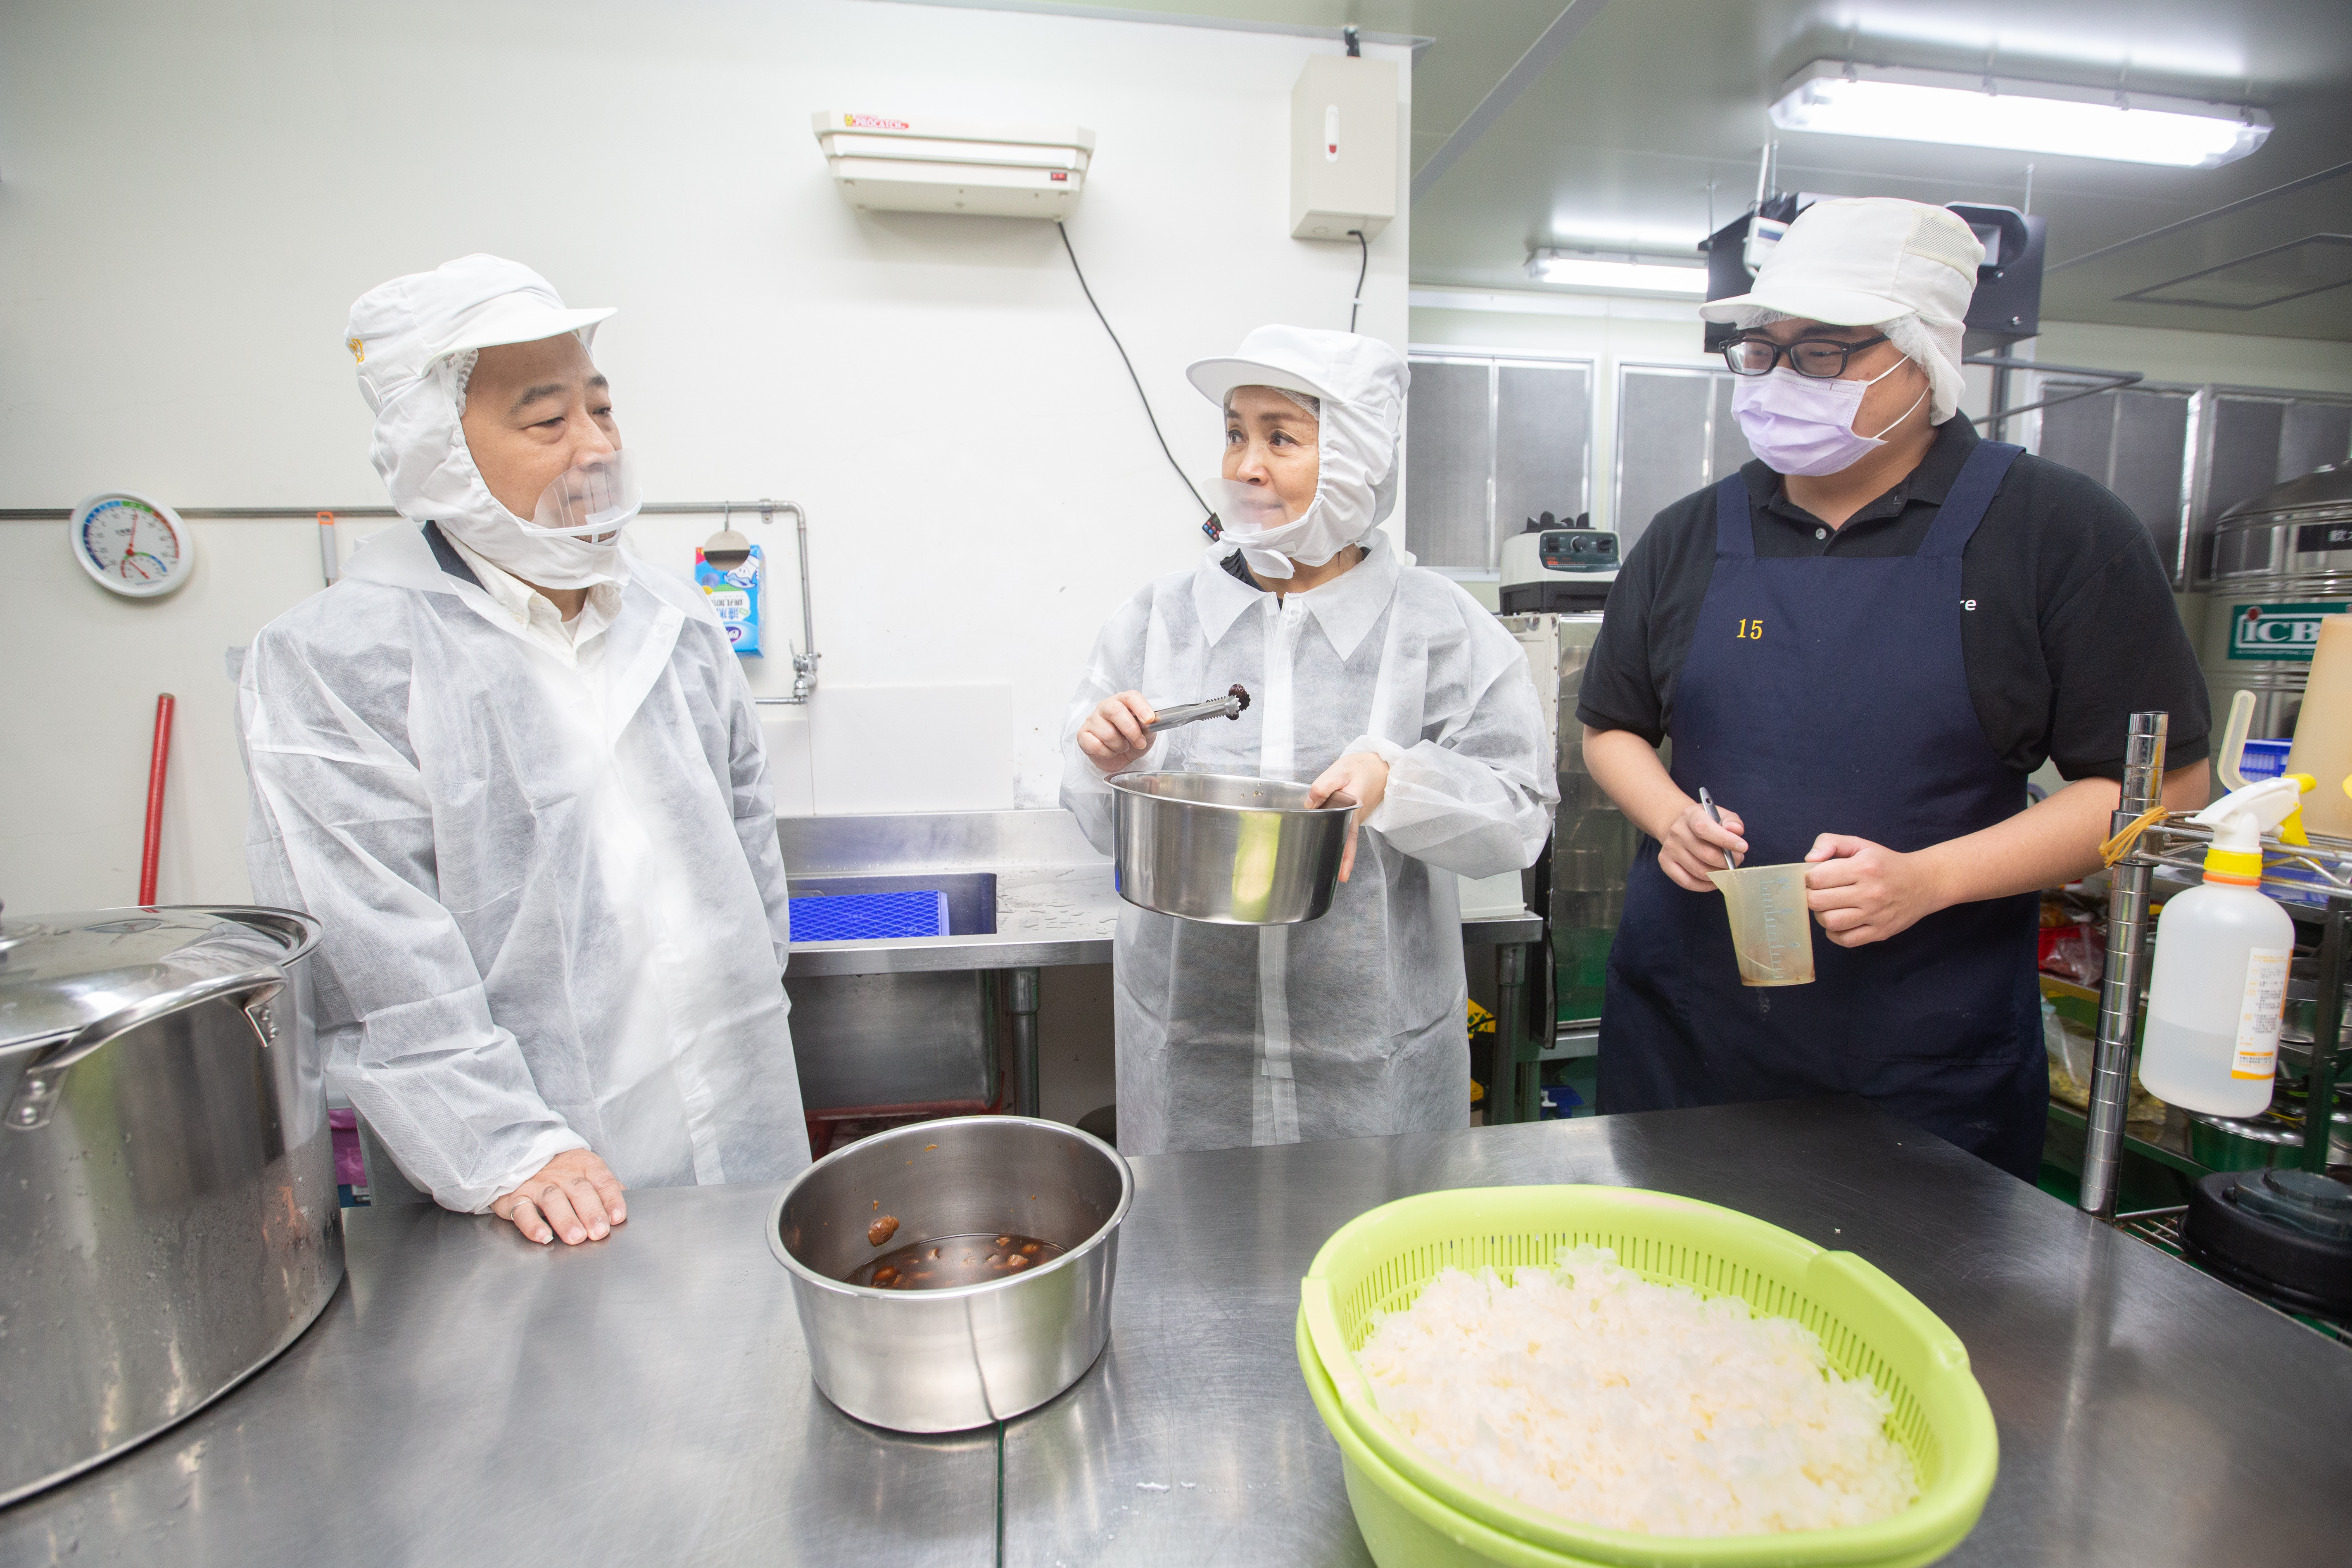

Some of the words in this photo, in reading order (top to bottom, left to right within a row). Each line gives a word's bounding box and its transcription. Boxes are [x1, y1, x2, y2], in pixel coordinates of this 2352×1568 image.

[855, 118, 902, 129] PROCATCH
[2327, 529, 2352, 542] 軟
[714, 607, 739, 620] 濾水
[1737, 618, 1763, 640] 15
